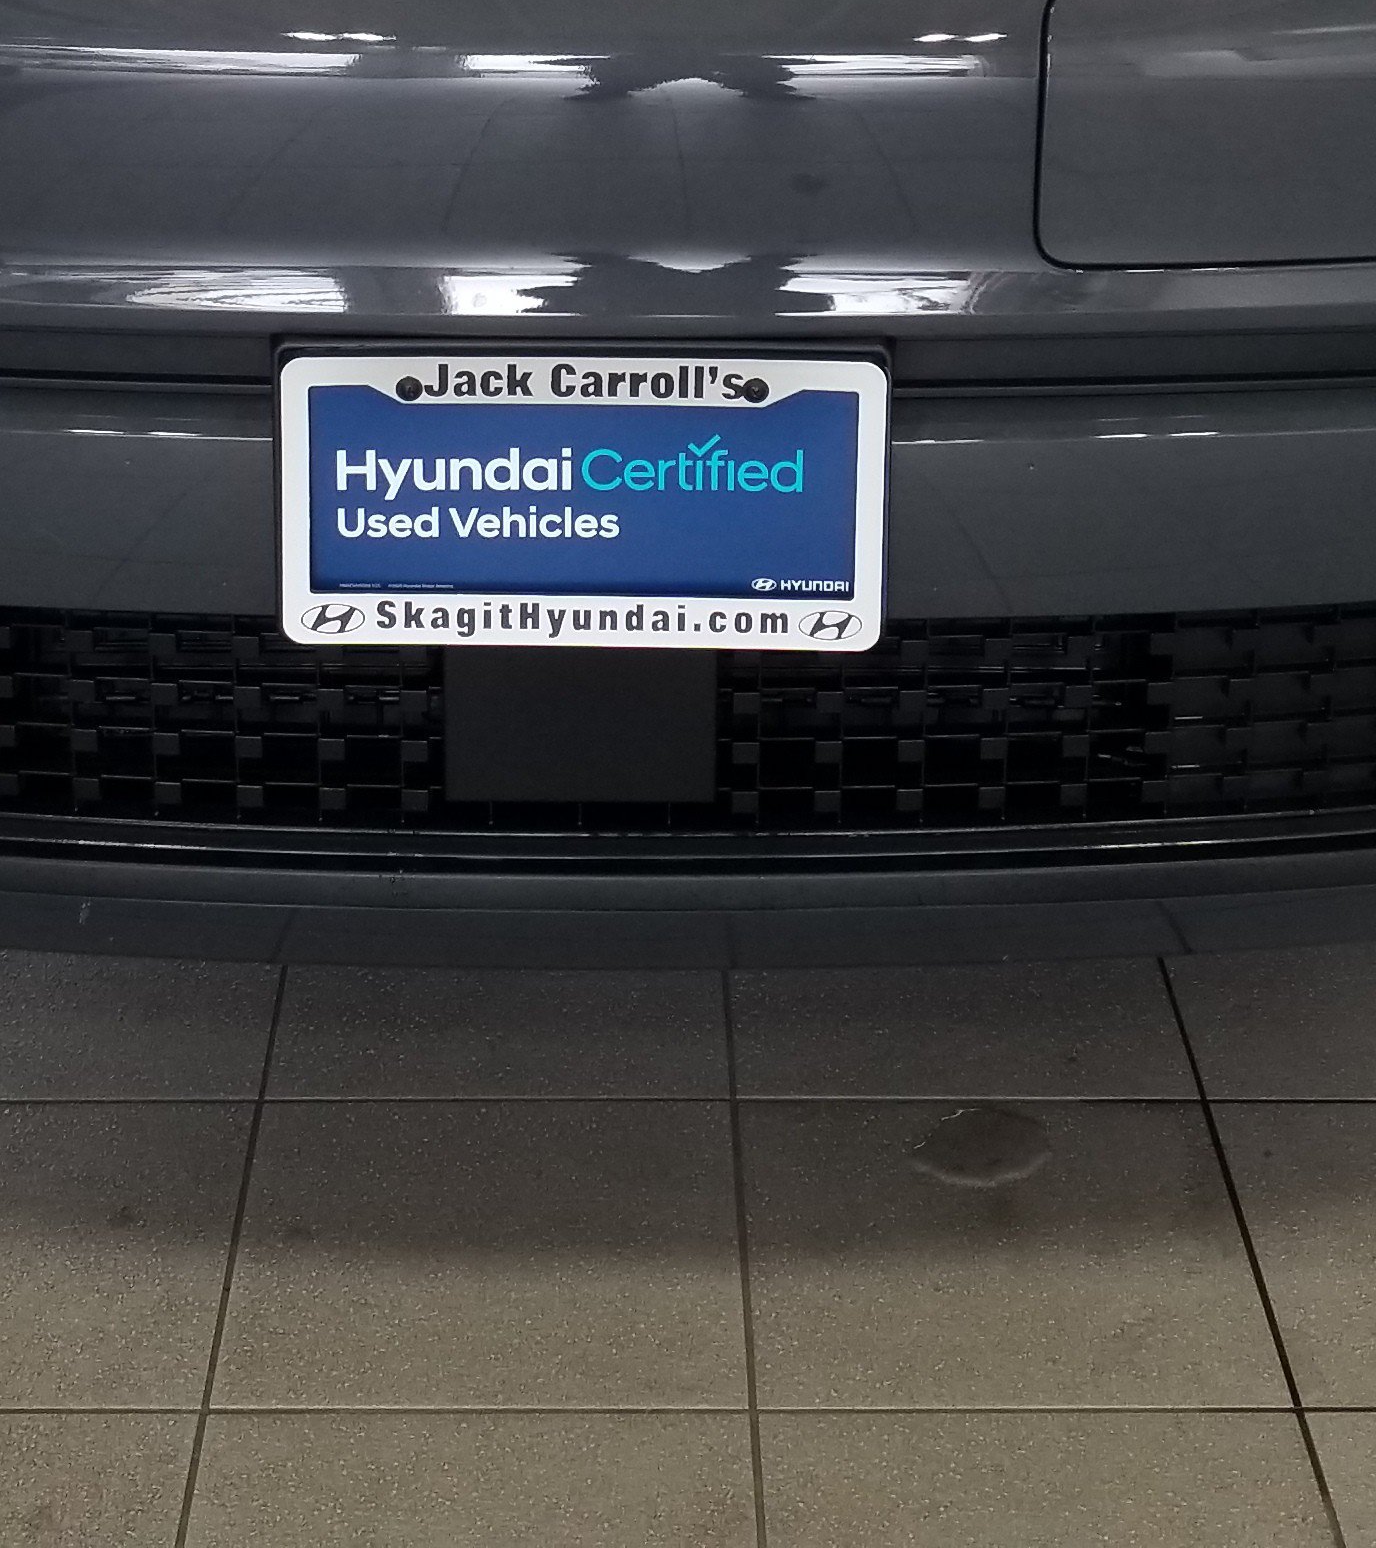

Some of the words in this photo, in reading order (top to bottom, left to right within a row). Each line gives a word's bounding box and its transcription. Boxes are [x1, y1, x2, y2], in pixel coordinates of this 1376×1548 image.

[424, 363, 533, 397] Jack
[550, 363, 744, 399] Carroll's
[336, 448, 572, 501] Hyundai
[582, 434, 803, 493] Certified
[337, 506, 439, 538] Used
[448, 506, 620, 538] Vehicles
[781, 579, 849, 592] HYUNDAI
[377, 600, 789, 637] SkagitHyundai.com
